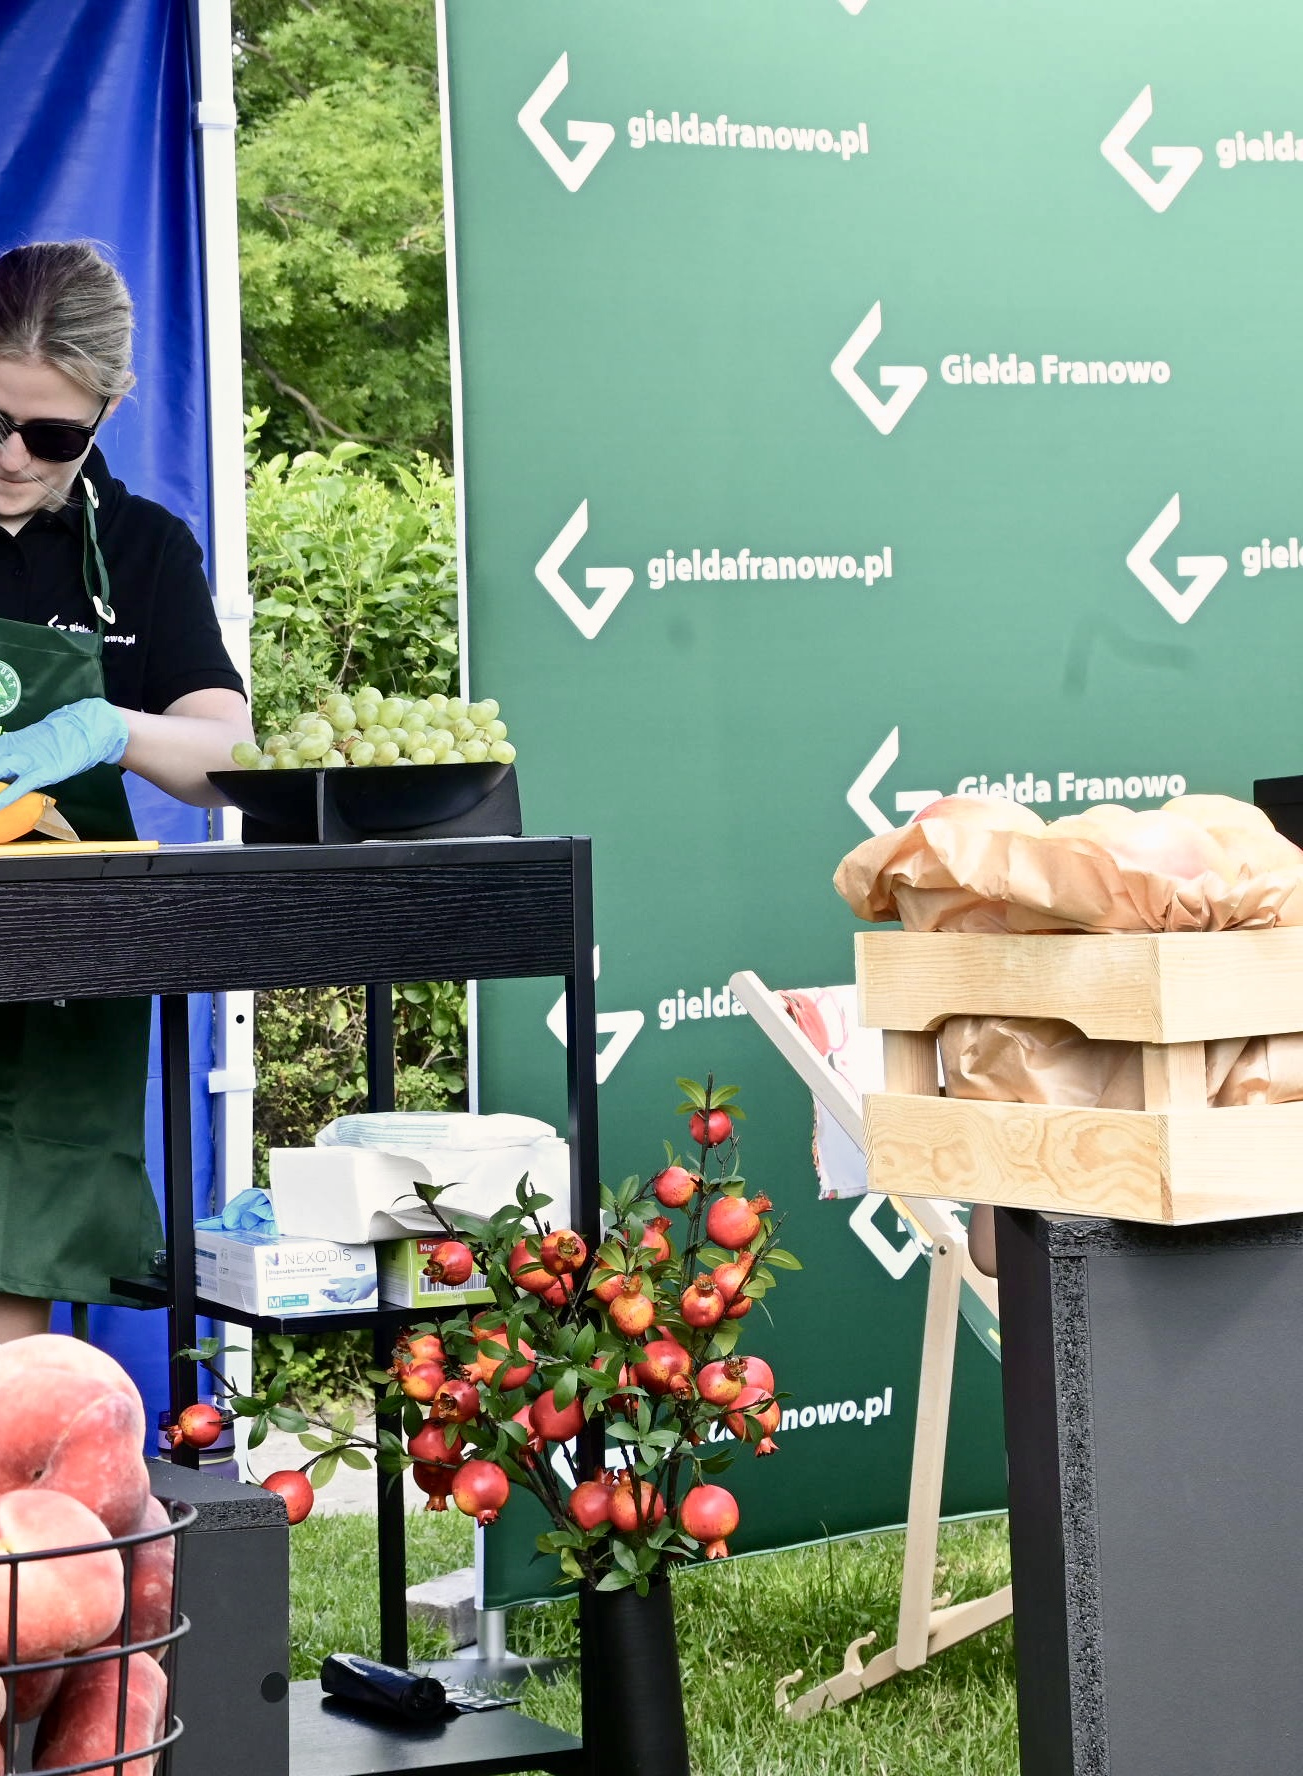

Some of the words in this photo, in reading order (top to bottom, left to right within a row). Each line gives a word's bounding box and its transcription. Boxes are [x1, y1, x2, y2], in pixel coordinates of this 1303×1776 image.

[627, 109, 869, 161] gieldafranowo.pl
[940, 353, 1036, 385] Giełda
[1041, 354, 1171, 385] Franowo
[647, 546, 893, 590] gieldafranowo.pl
[1241, 537, 1303, 577] giel
[1056, 771, 1187, 801] Franowo
[283, 1248, 352, 1266] NEXODIS
[268, 1296, 280, 1308] M
